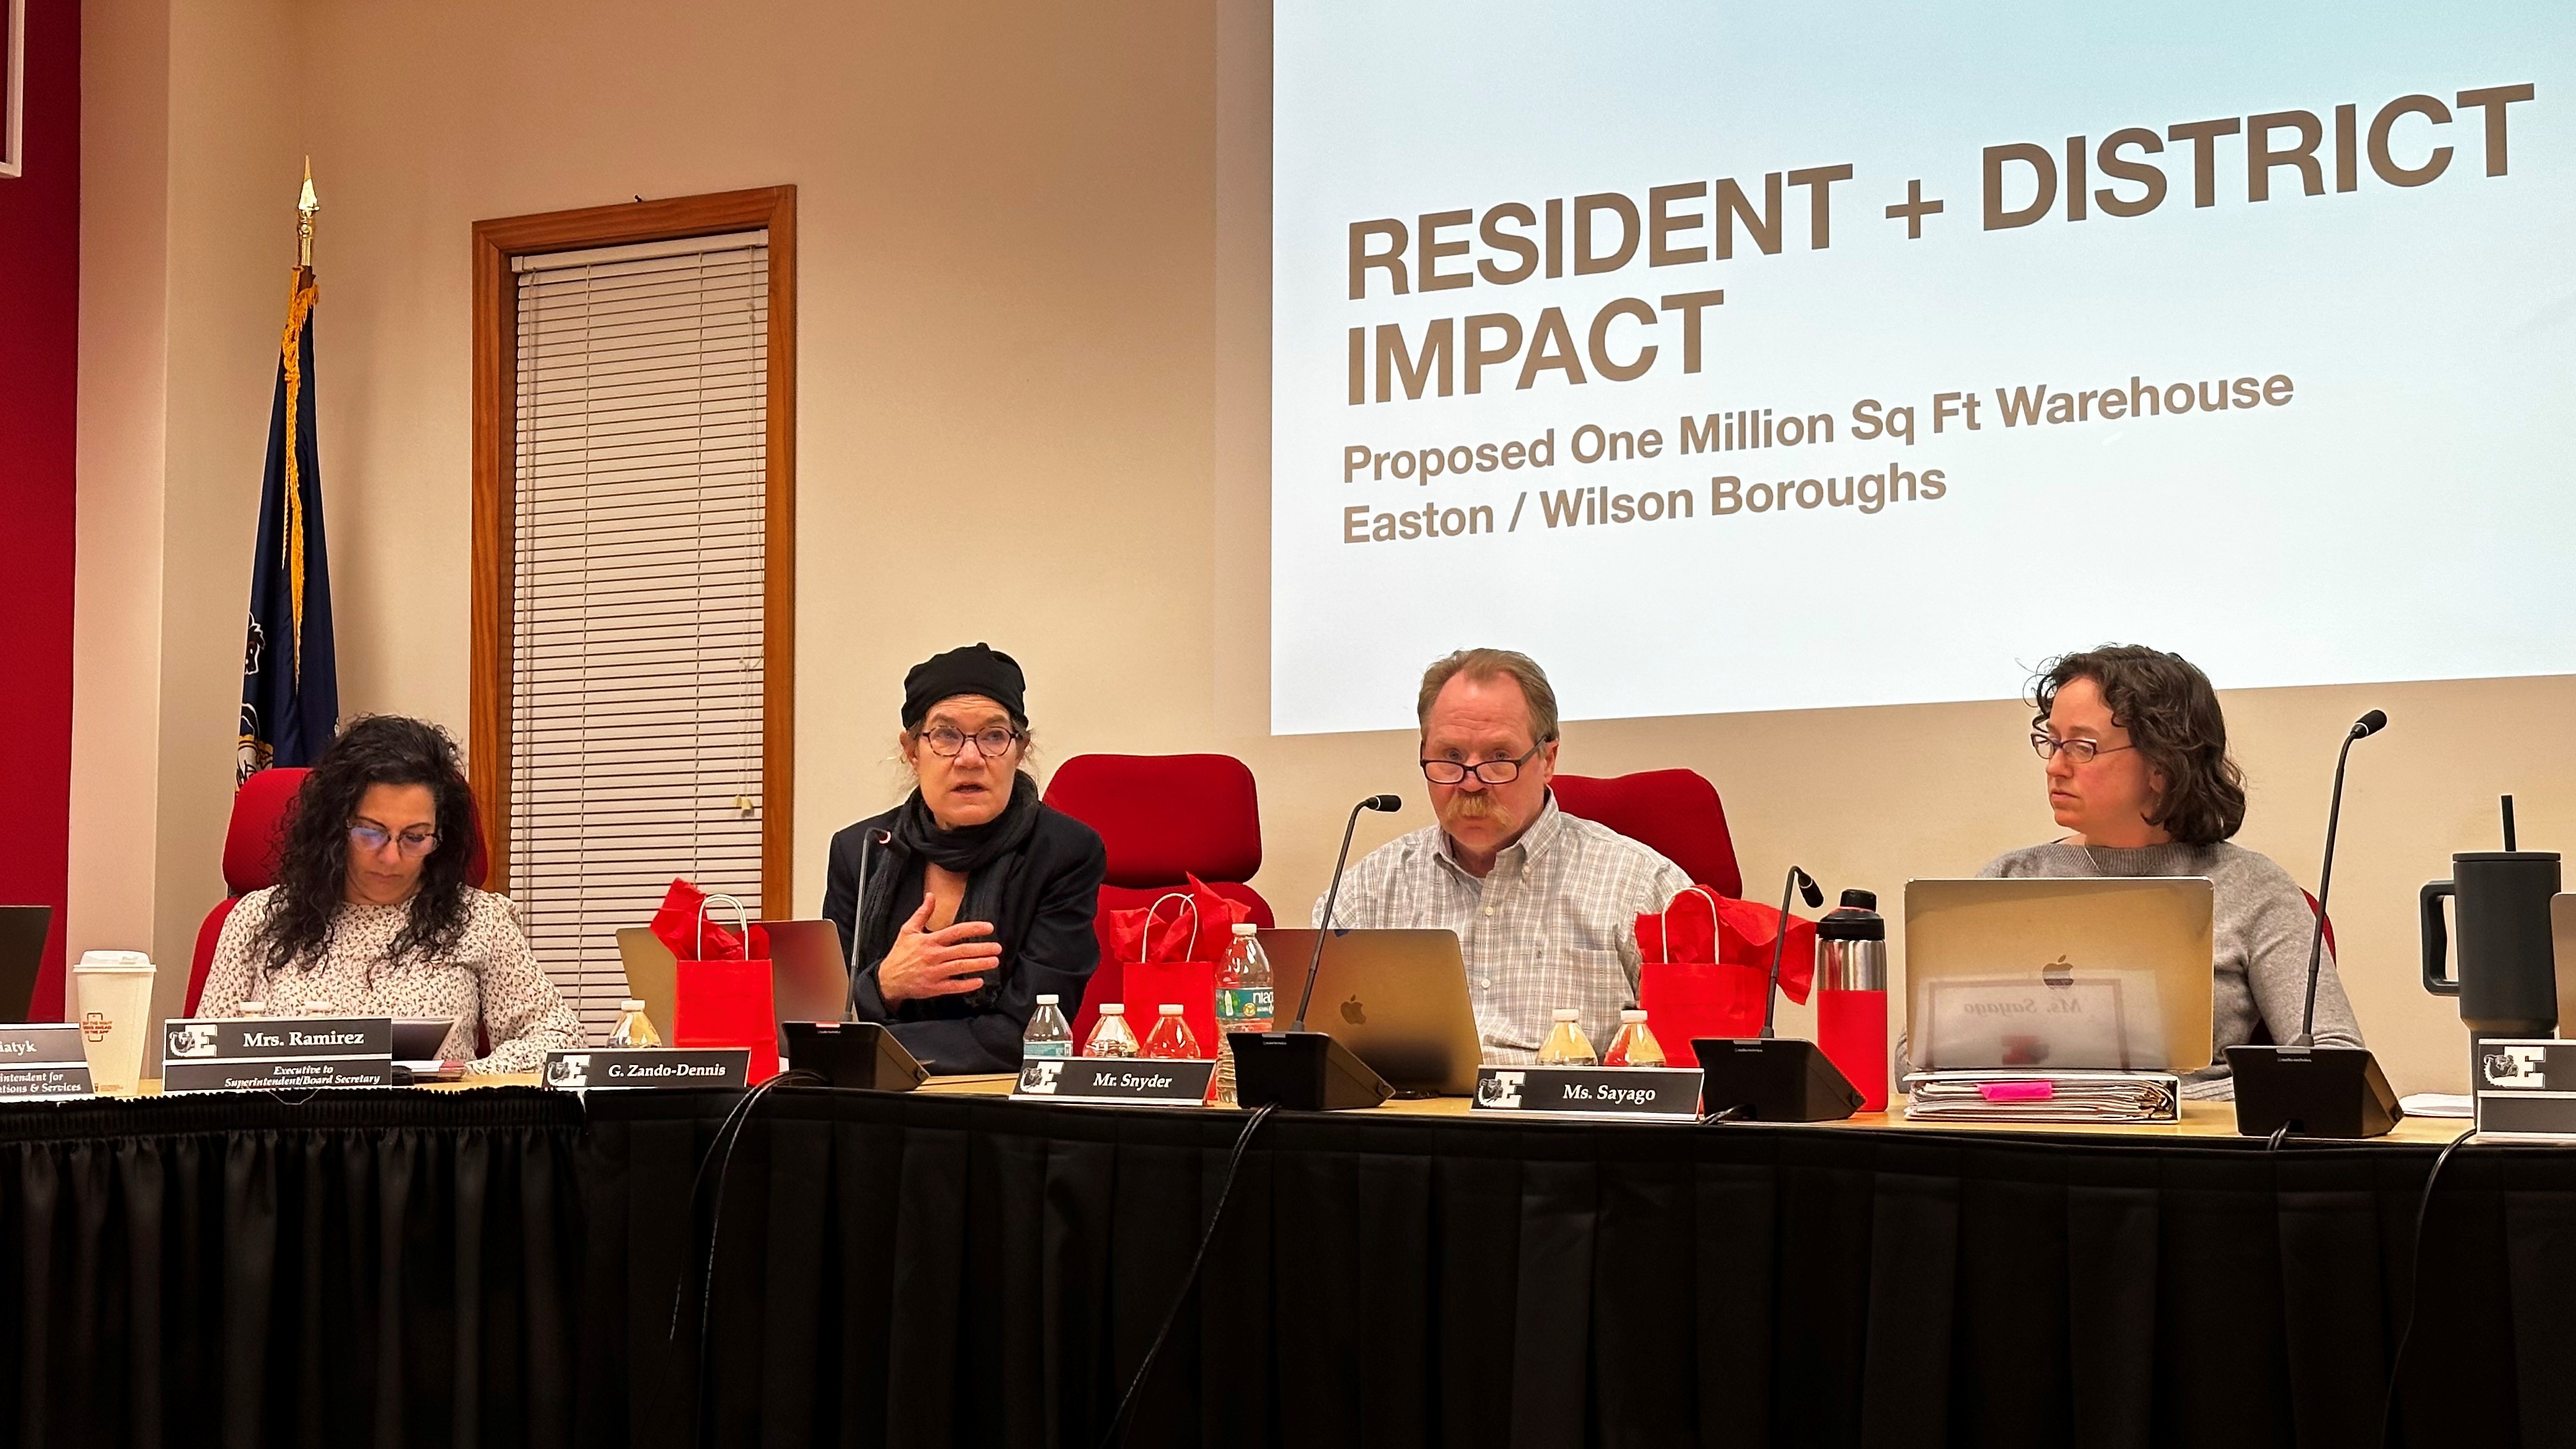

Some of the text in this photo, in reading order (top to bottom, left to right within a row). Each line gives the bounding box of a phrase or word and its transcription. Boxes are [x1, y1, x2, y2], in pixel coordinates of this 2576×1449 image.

[1349, 84, 2533, 300] RESIDENT + DISTRICT
[1348, 289, 1724, 406] IMPACT
[1344, 374, 2294, 486] Proposed One Million Sq Ft Warehouse
[1344, 470, 1947, 544] Easton / Wilson Boroughs
[243, 1030, 364, 1047] Mrs. Ramirez
[49, 1071, 64, 1083] for
[273, 1065, 334, 1075] Executive to
[608, 1063, 726, 1077] G. Zando-Dennis
[30, 1083, 40, 1092] &
[42, 1082, 82, 1092] Services
[224, 1074, 381, 1089] Superintendent/Board Secretary
[1092, 1073, 1173, 1091] Mr. Snyder
[1563, 1084, 1656, 1105] Ms. Sayago
